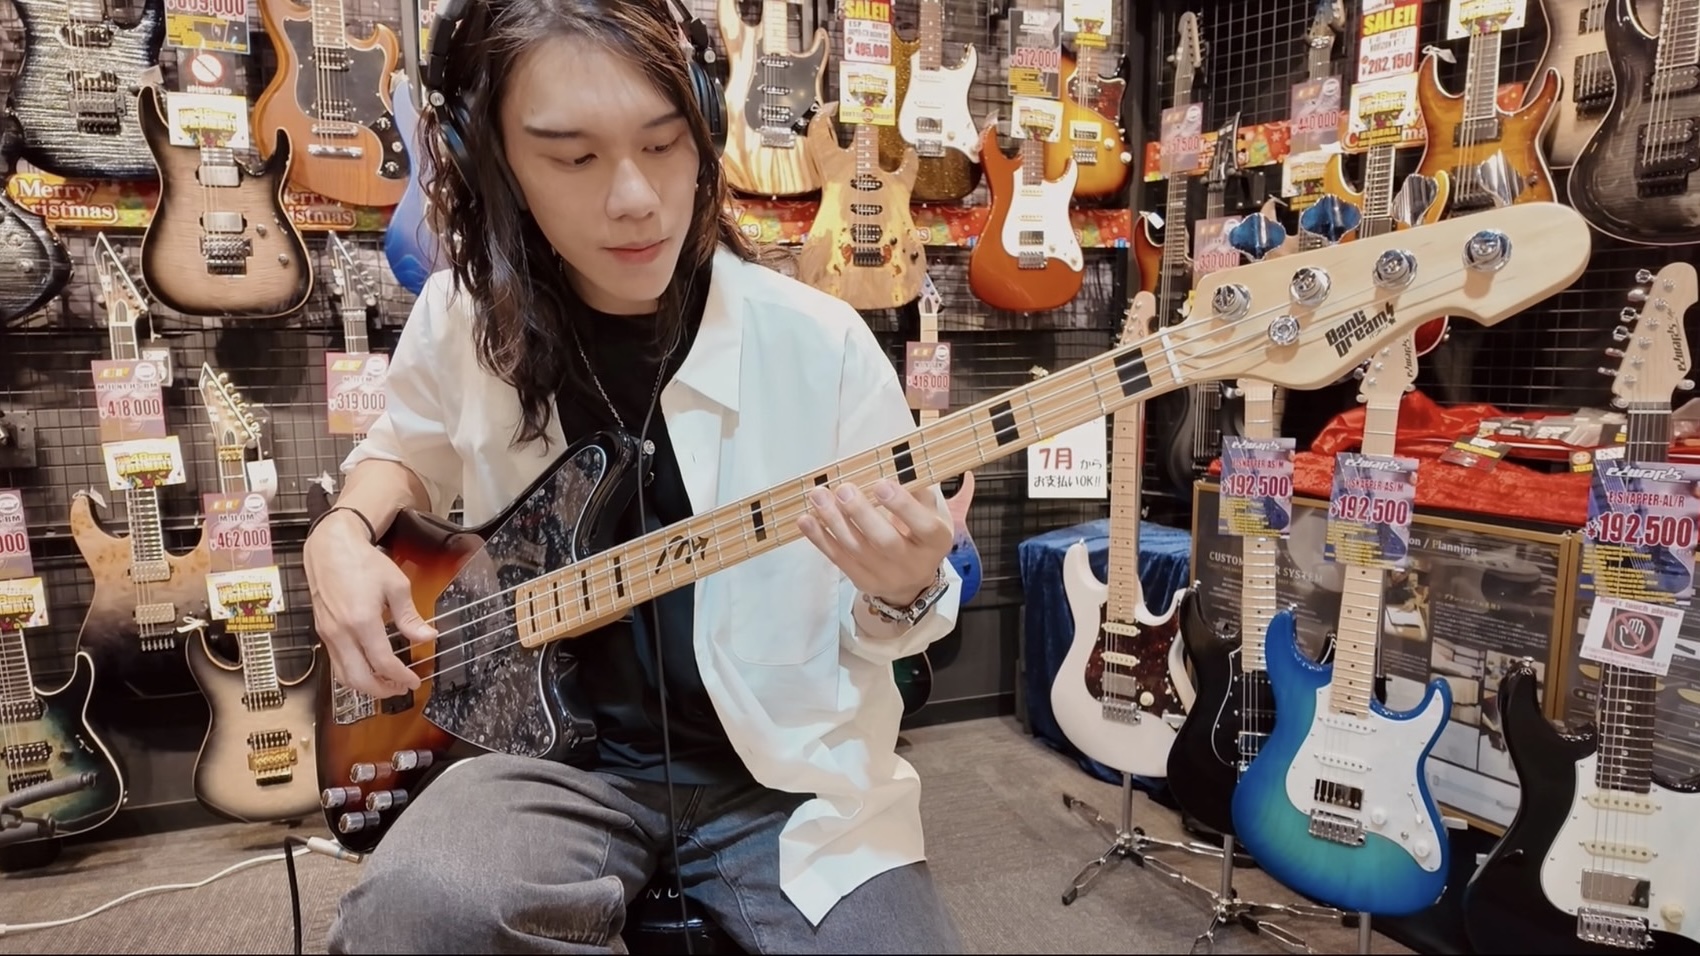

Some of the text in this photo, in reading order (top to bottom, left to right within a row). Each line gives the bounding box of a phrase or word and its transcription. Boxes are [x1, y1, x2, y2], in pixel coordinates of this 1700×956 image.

[1363, 4, 1418, 36] SALE!!
[20, 180, 90, 201] Merry
[30, 200, 113, 219] ristmas
[288, 206, 352, 225] istmas
[1606, 465, 1683, 481] edwards
[1331, 495, 1408, 525] ¥192,500
[1587, 512, 1693, 549] ¥192,500
[1432, 539, 1478, 558] Planning
